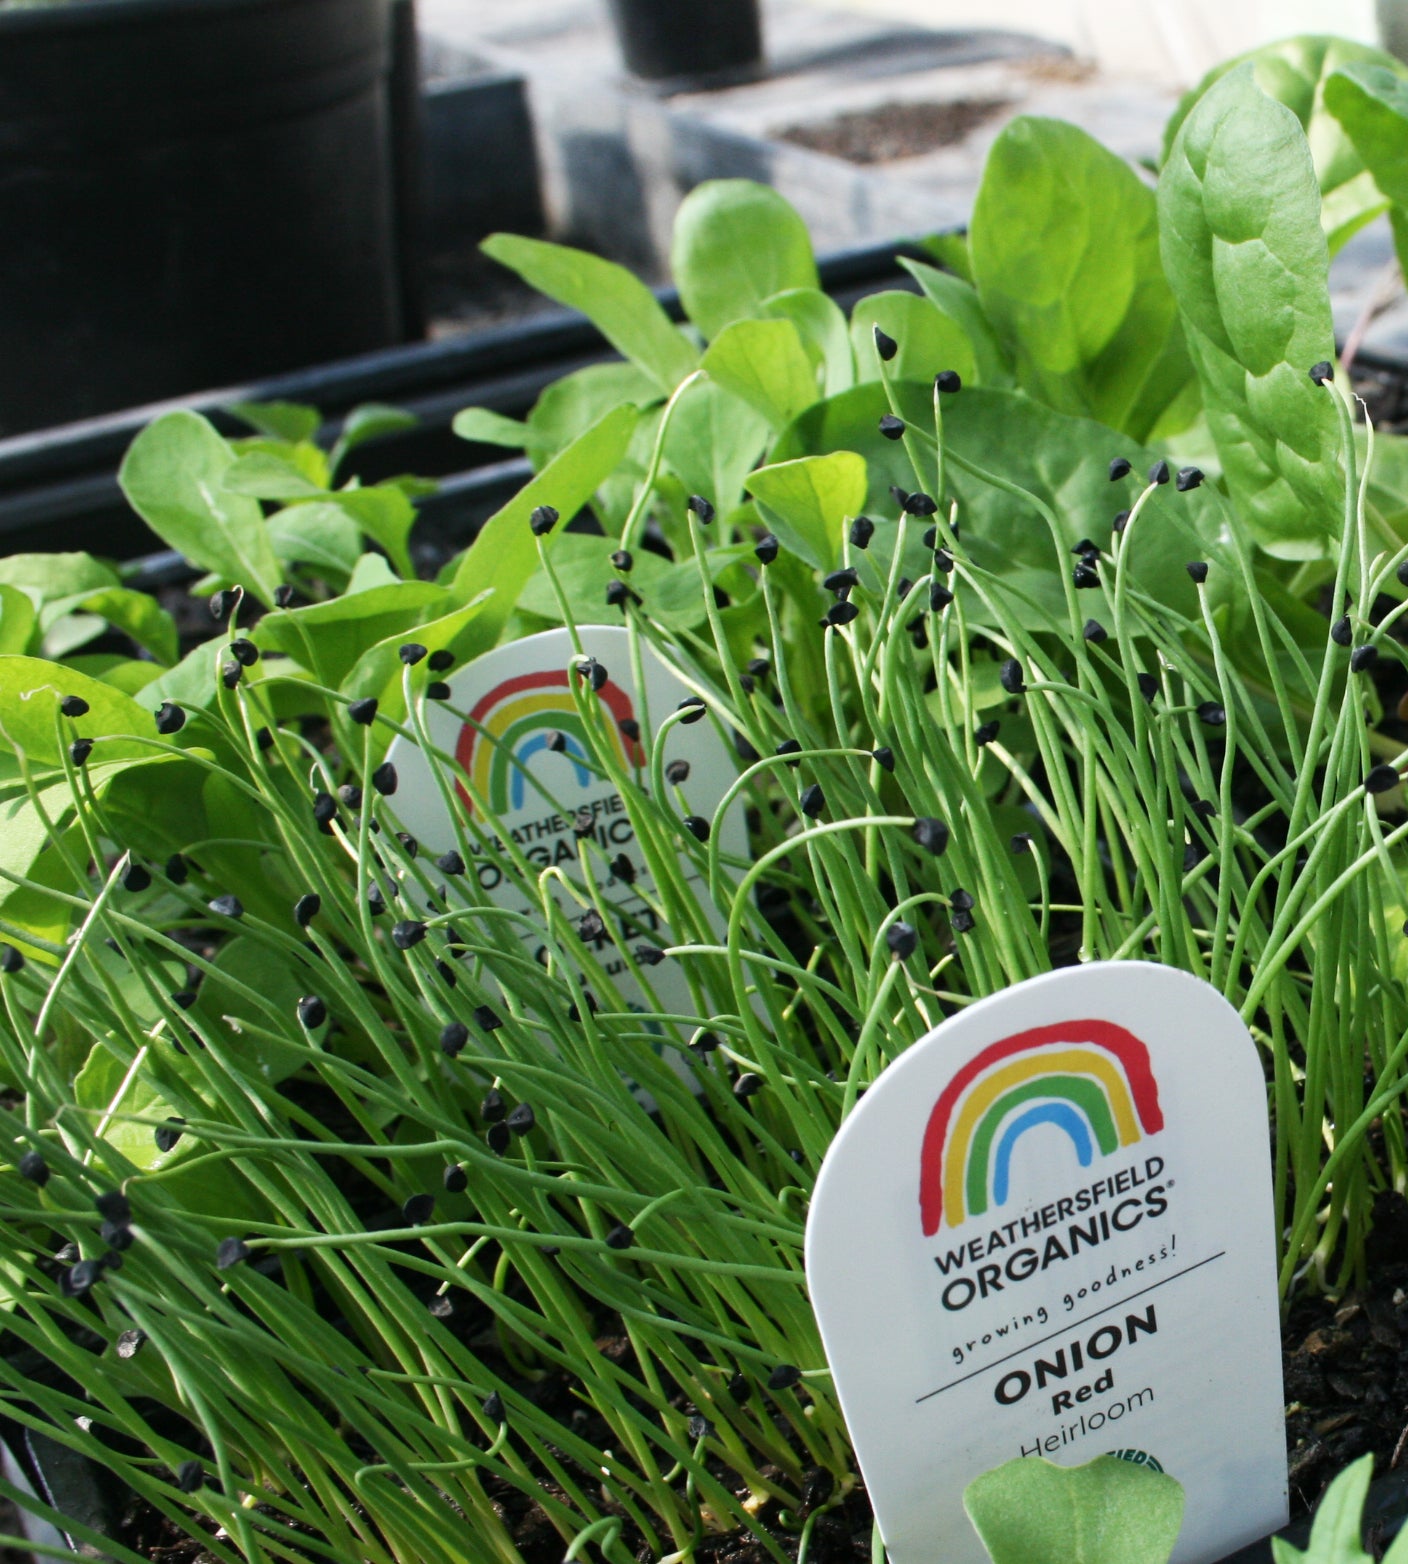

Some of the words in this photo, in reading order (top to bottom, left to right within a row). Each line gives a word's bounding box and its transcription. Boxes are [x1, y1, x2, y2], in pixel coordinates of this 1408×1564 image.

[933, 1155, 1165, 1276] WEATHERSFIELD
[940, 1184, 1169, 1312] ORGANICS
[951, 1306, 1049, 1366] growing
[1062, 1233, 1177, 1311] goodness!
[993, 1303, 1159, 1406] ONION
[1020, 1385, 1155, 1459] Heirloom
[1051, 1367, 1115, 1417] Red
